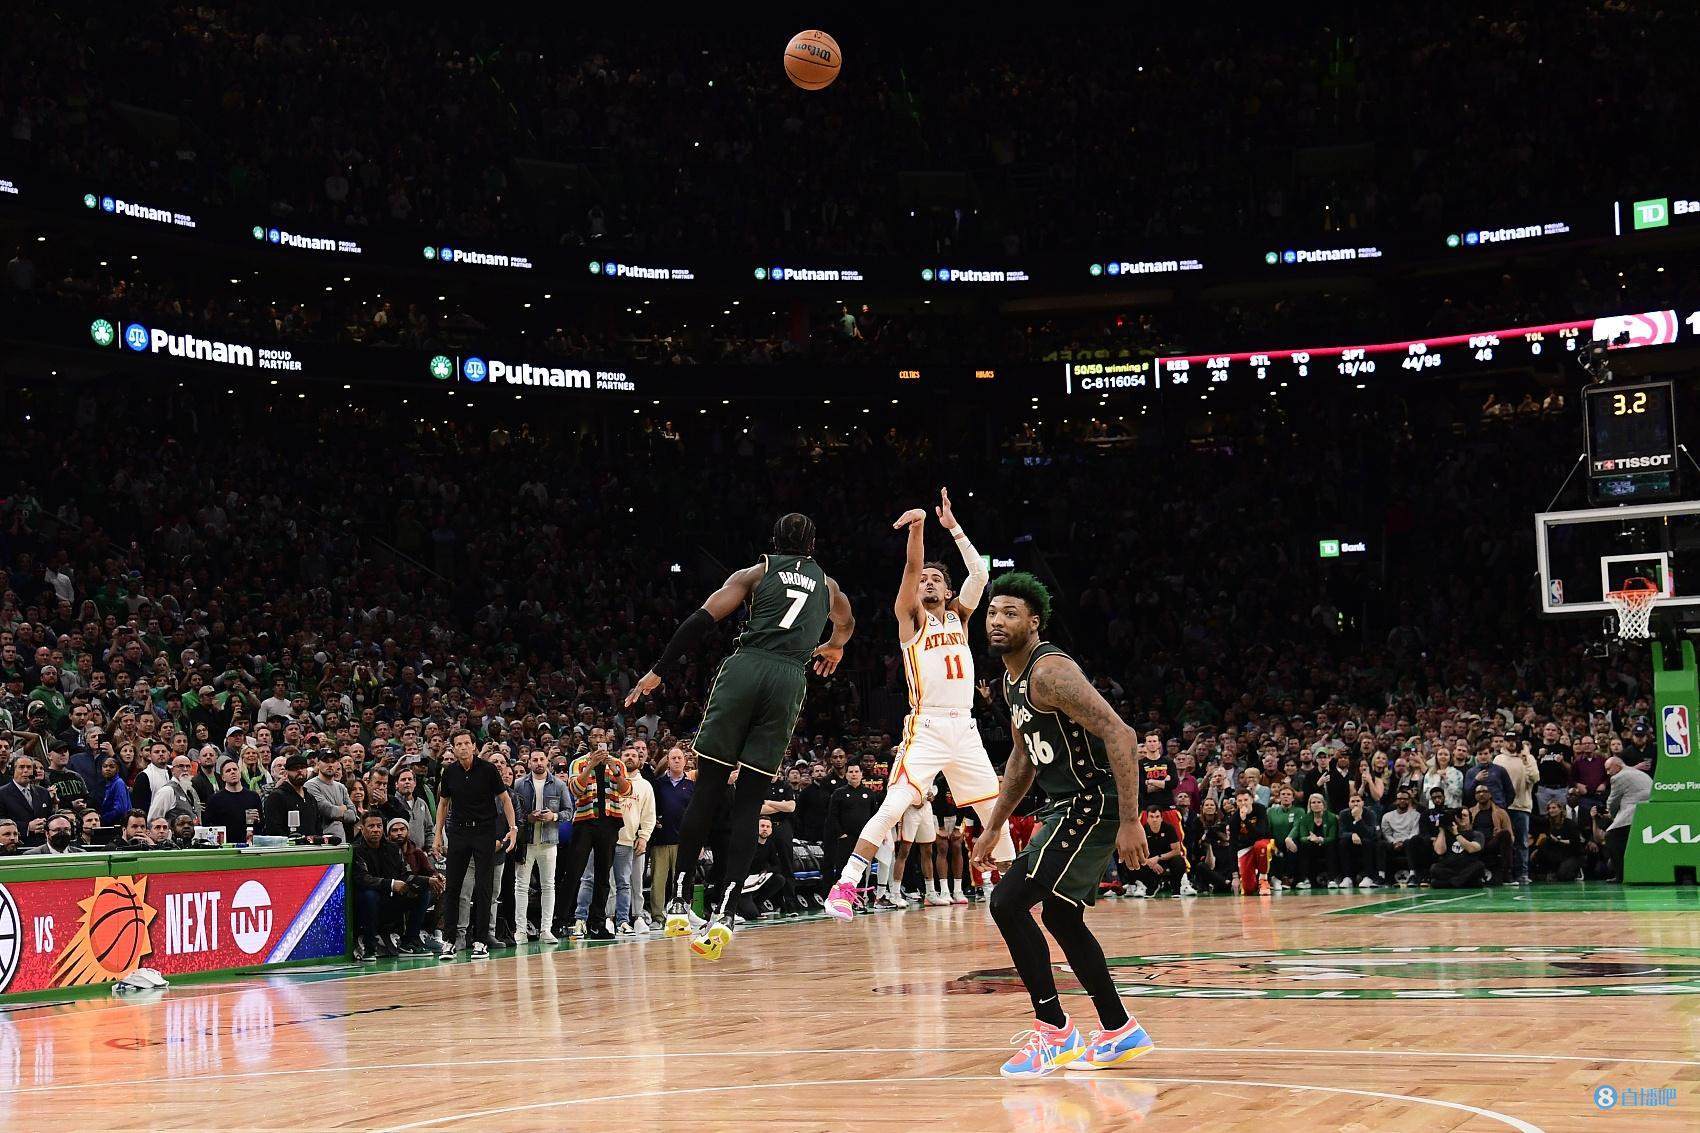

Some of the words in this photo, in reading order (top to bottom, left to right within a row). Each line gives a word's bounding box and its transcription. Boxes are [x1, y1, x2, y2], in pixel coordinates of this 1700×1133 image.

[116, 200, 171, 223] Putnam
[1637, 204, 1665, 224] TD
[281, 232, 335, 250] Putnam
[1479, 225, 1541, 243] Putnam
[454, 250, 508, 266] Putnam
[1297, 248, 1356, 262] Putnam
[617, 264, 669, 279] Putnam
[784, 268, 839, 281] Putnam
[1121, 260, 1177, 274] Putnam
[951, 269, 1004, 282] Putnam
[1559, 328, 1579, 338] FLS
[151, 329, 253, 366] Putnam
[1532, 343, 1541, 354] 0
[1567, 339, 1576, 351] 5
[259, 349, 292, 360] PROUD
[1167, 360, 1190, 371] REB
[1207, 357, 1231, 369] AST
[1250, 355, 1270, 366] STL
[1291, 352, 1310, 363] TO
[1342, 349, 1366, 361] 3PT
[259, 359, 302, 371] PARTNER
[1074, 364, 1103, 375] 50/50
[1105, 363, 1141, 373] winning
[1173, 372, 1189, 384] 34
[1212, 370, 1228, 382] 26
[1257, 367, 1266, 379] 5
[1338, 361, 1376, 377] 18/40
[489, 360, 591, 388] Putnam
[597, 371, 626, 381] PROUD
[597, 380, 635, 391] PARTNER
[1082, 374, 1146, 390] C-8116054
[1614, 392, 1647, 415] 3.2
[1615, 455, 1671, 469] TISSOT
[1341, 542, 1365, 552] Bank
[993, 559, 1015, 568] Bank
[778, 571, 817, 593] BROWN
[779, 588, 809, 629] 7
[944, 655, 964, 679] 11
[1024, 731, 1054, 766] 36
[1655, 782, 1686, 791] Google
[34, 915, 54, 954] VS
[165, 891, 221, 955] NEXT
